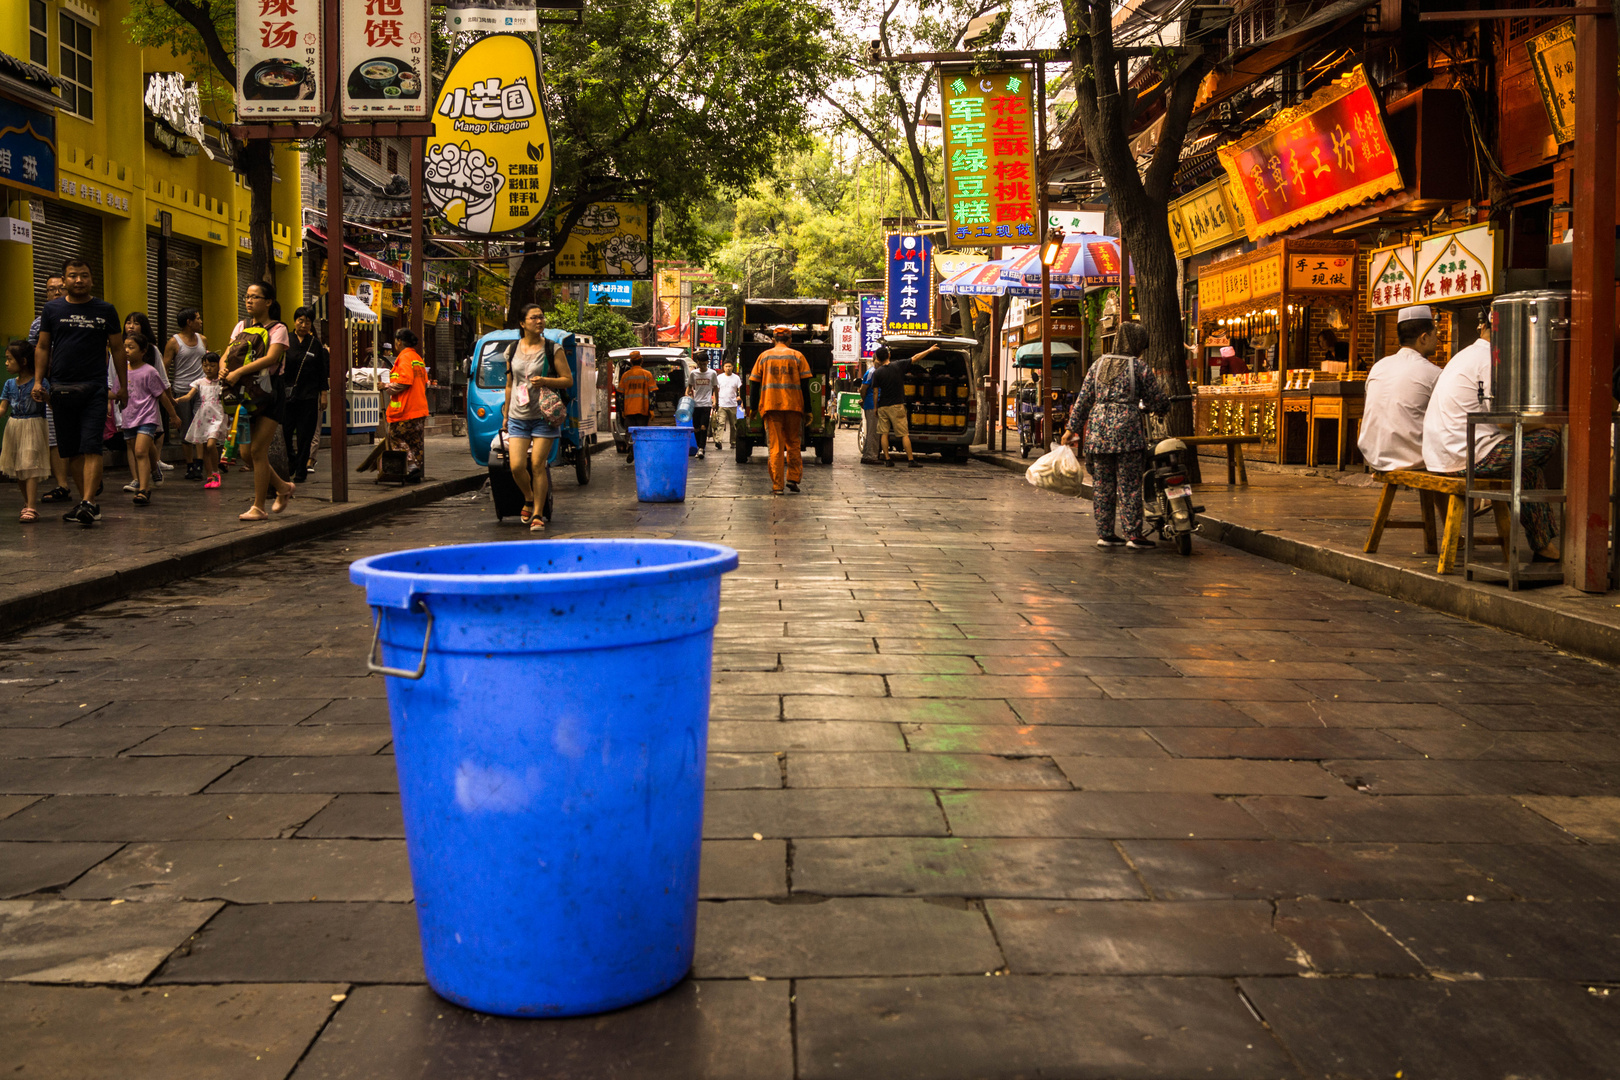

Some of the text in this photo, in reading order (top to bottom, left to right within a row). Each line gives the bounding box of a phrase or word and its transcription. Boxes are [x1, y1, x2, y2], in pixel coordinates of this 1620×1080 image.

[363, 0, 405, 48] 泡馍
[949, 76, 1023, 96] 清 真
[438, 77, 537, 120] 小芒国
[454, 120, 530, 135] Mango Kingdom
[508, 164, 539, 176] 芒果酥
[949, 97, 991, 225] 军军绿豆糕
[509, 191, 540, 204] 伴手礼
[509, 205, 530, 217] 甜品
[954, 222, 1034, 239] 手工现做
[1098, 246, 1114, 271] 王老吉
[1296, 258, 1329, 272] 手工
[900, 261, 919, 320] 风干牛肉干
[842, 325, 853, 352] 皮影戏
